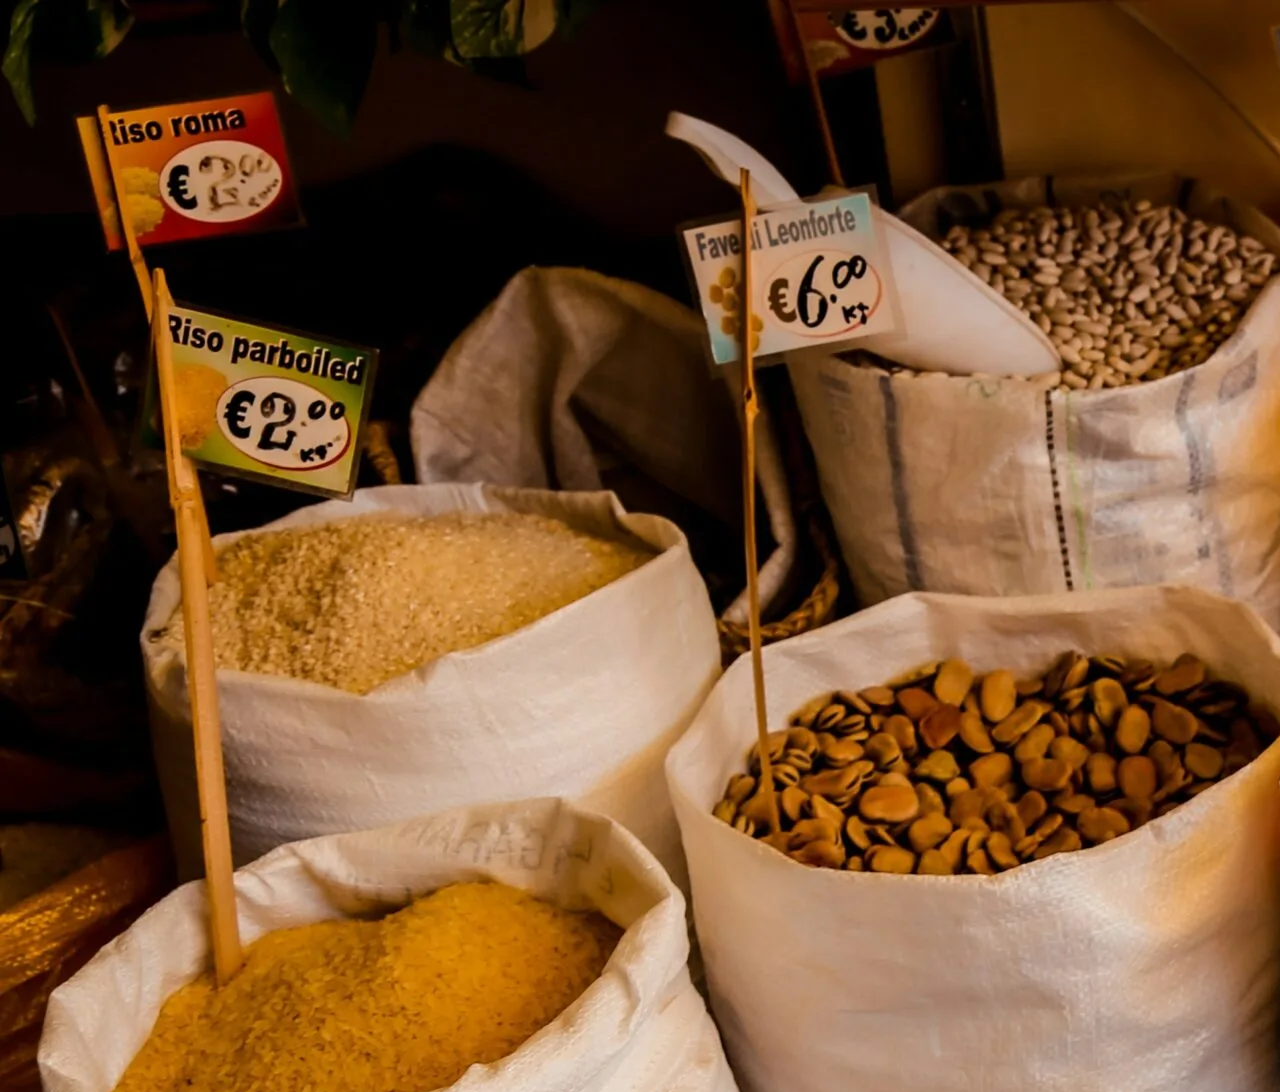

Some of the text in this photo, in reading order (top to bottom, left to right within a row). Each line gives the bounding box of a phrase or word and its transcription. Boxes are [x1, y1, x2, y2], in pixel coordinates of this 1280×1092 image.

[171, 108, 246, 137] roma
[694, 232, 740, 261] Fave
[763, 205, 856, 247] Leonforte
[168, 314, 365, 386] Riso parboiled
